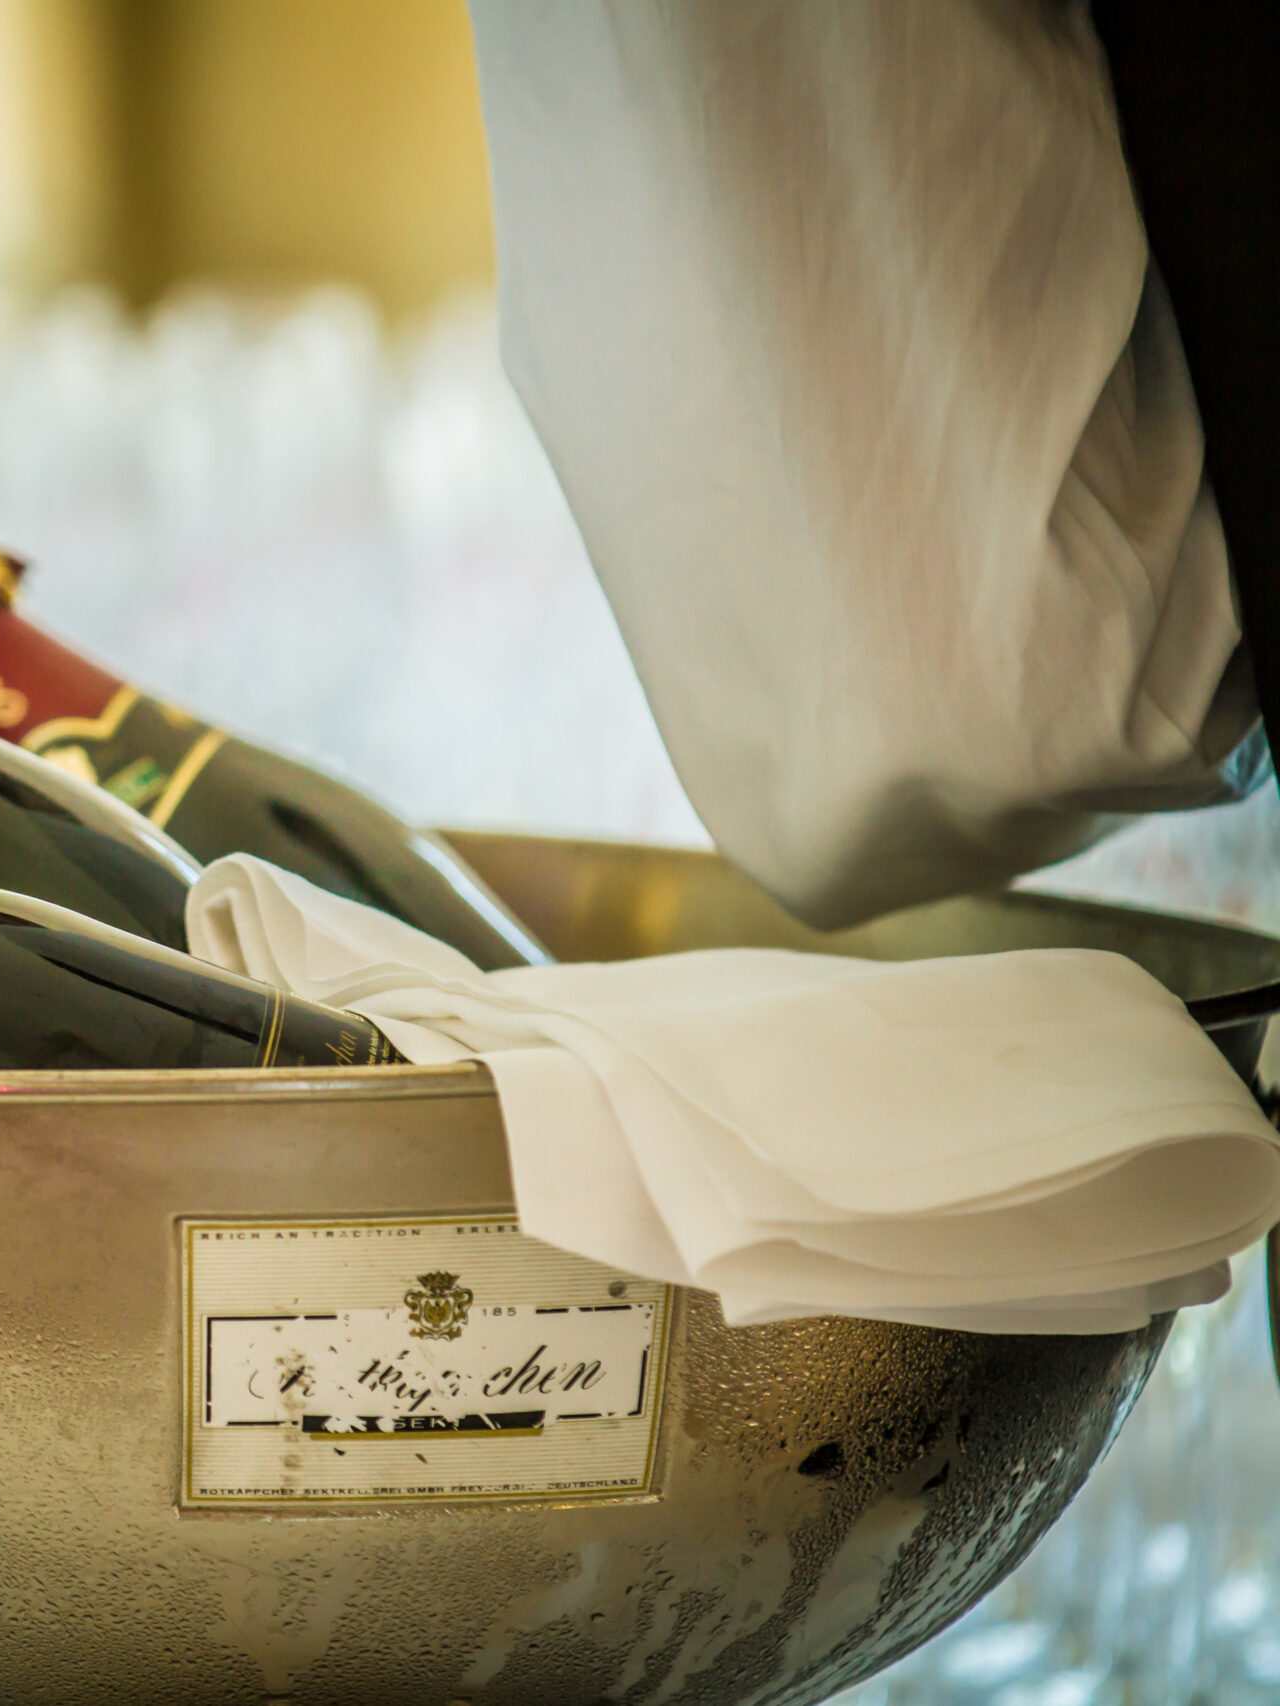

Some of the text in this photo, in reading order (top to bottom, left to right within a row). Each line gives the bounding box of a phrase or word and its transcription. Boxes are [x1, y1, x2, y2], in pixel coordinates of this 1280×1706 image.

[200, 1231, 261, 1241] REICH
[275, 1231, 299, 1240] AN
[456, 1224, 521, 1235] ERLES
